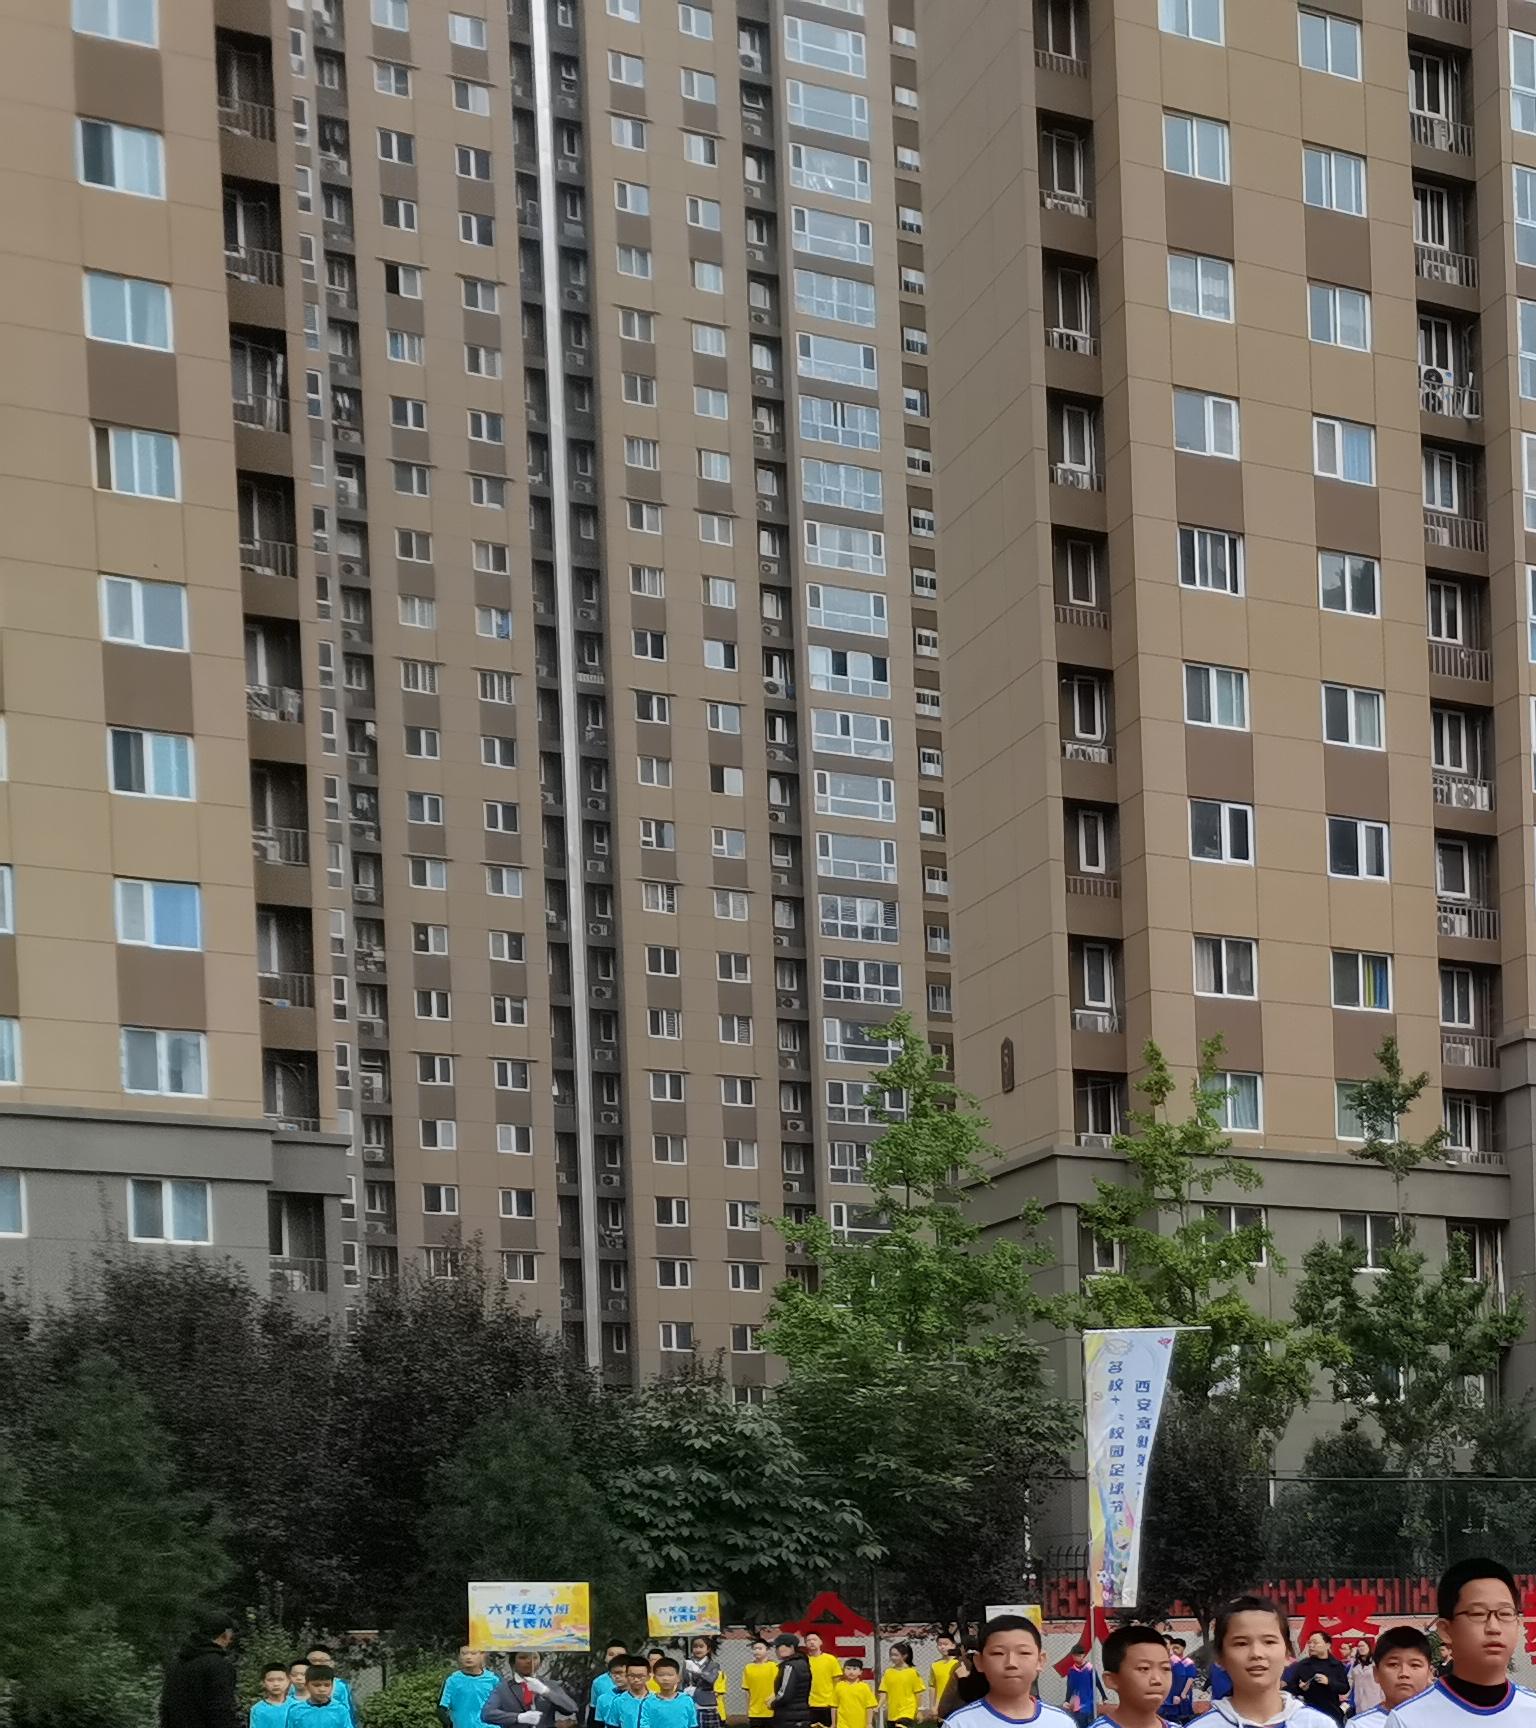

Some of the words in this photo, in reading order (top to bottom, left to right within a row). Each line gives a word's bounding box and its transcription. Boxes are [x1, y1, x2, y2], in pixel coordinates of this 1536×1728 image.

[488, 1603, 570, 1615] 六年级六班
[505, 1618, 553, 1629] 代表队
